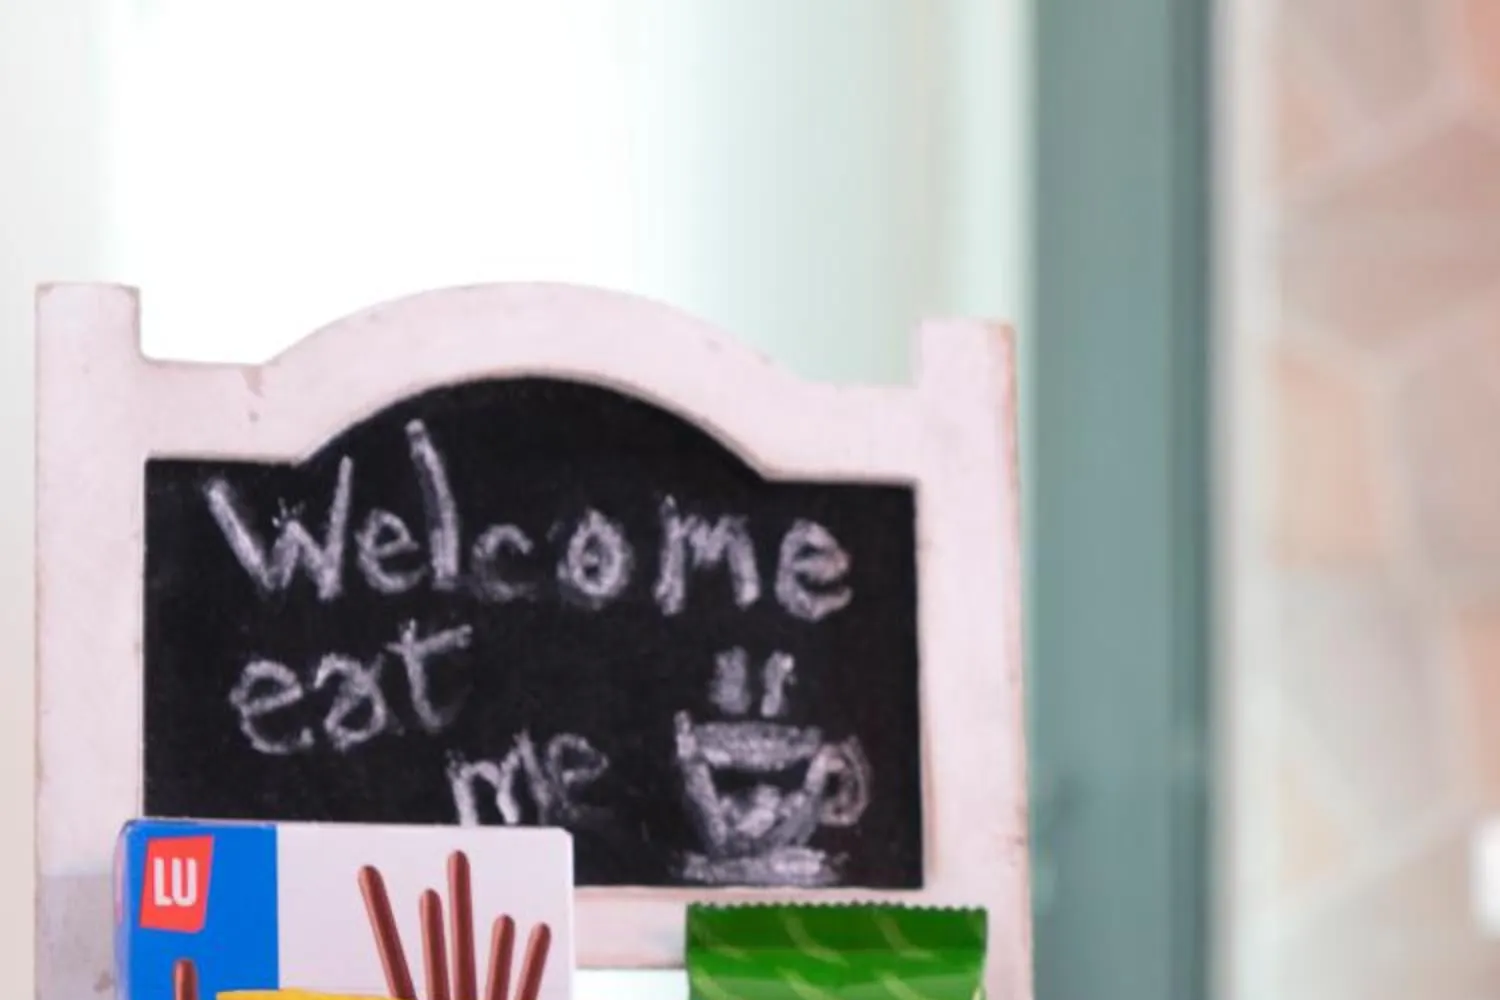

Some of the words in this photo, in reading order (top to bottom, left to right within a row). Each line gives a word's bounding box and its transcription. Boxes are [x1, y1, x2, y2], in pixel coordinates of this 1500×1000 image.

[203, 418, 854, 621] Welcome
[230, 617, 473, 755] eat
[446, 728, 609, 826] me
[152, 846, 198, 907] LU
